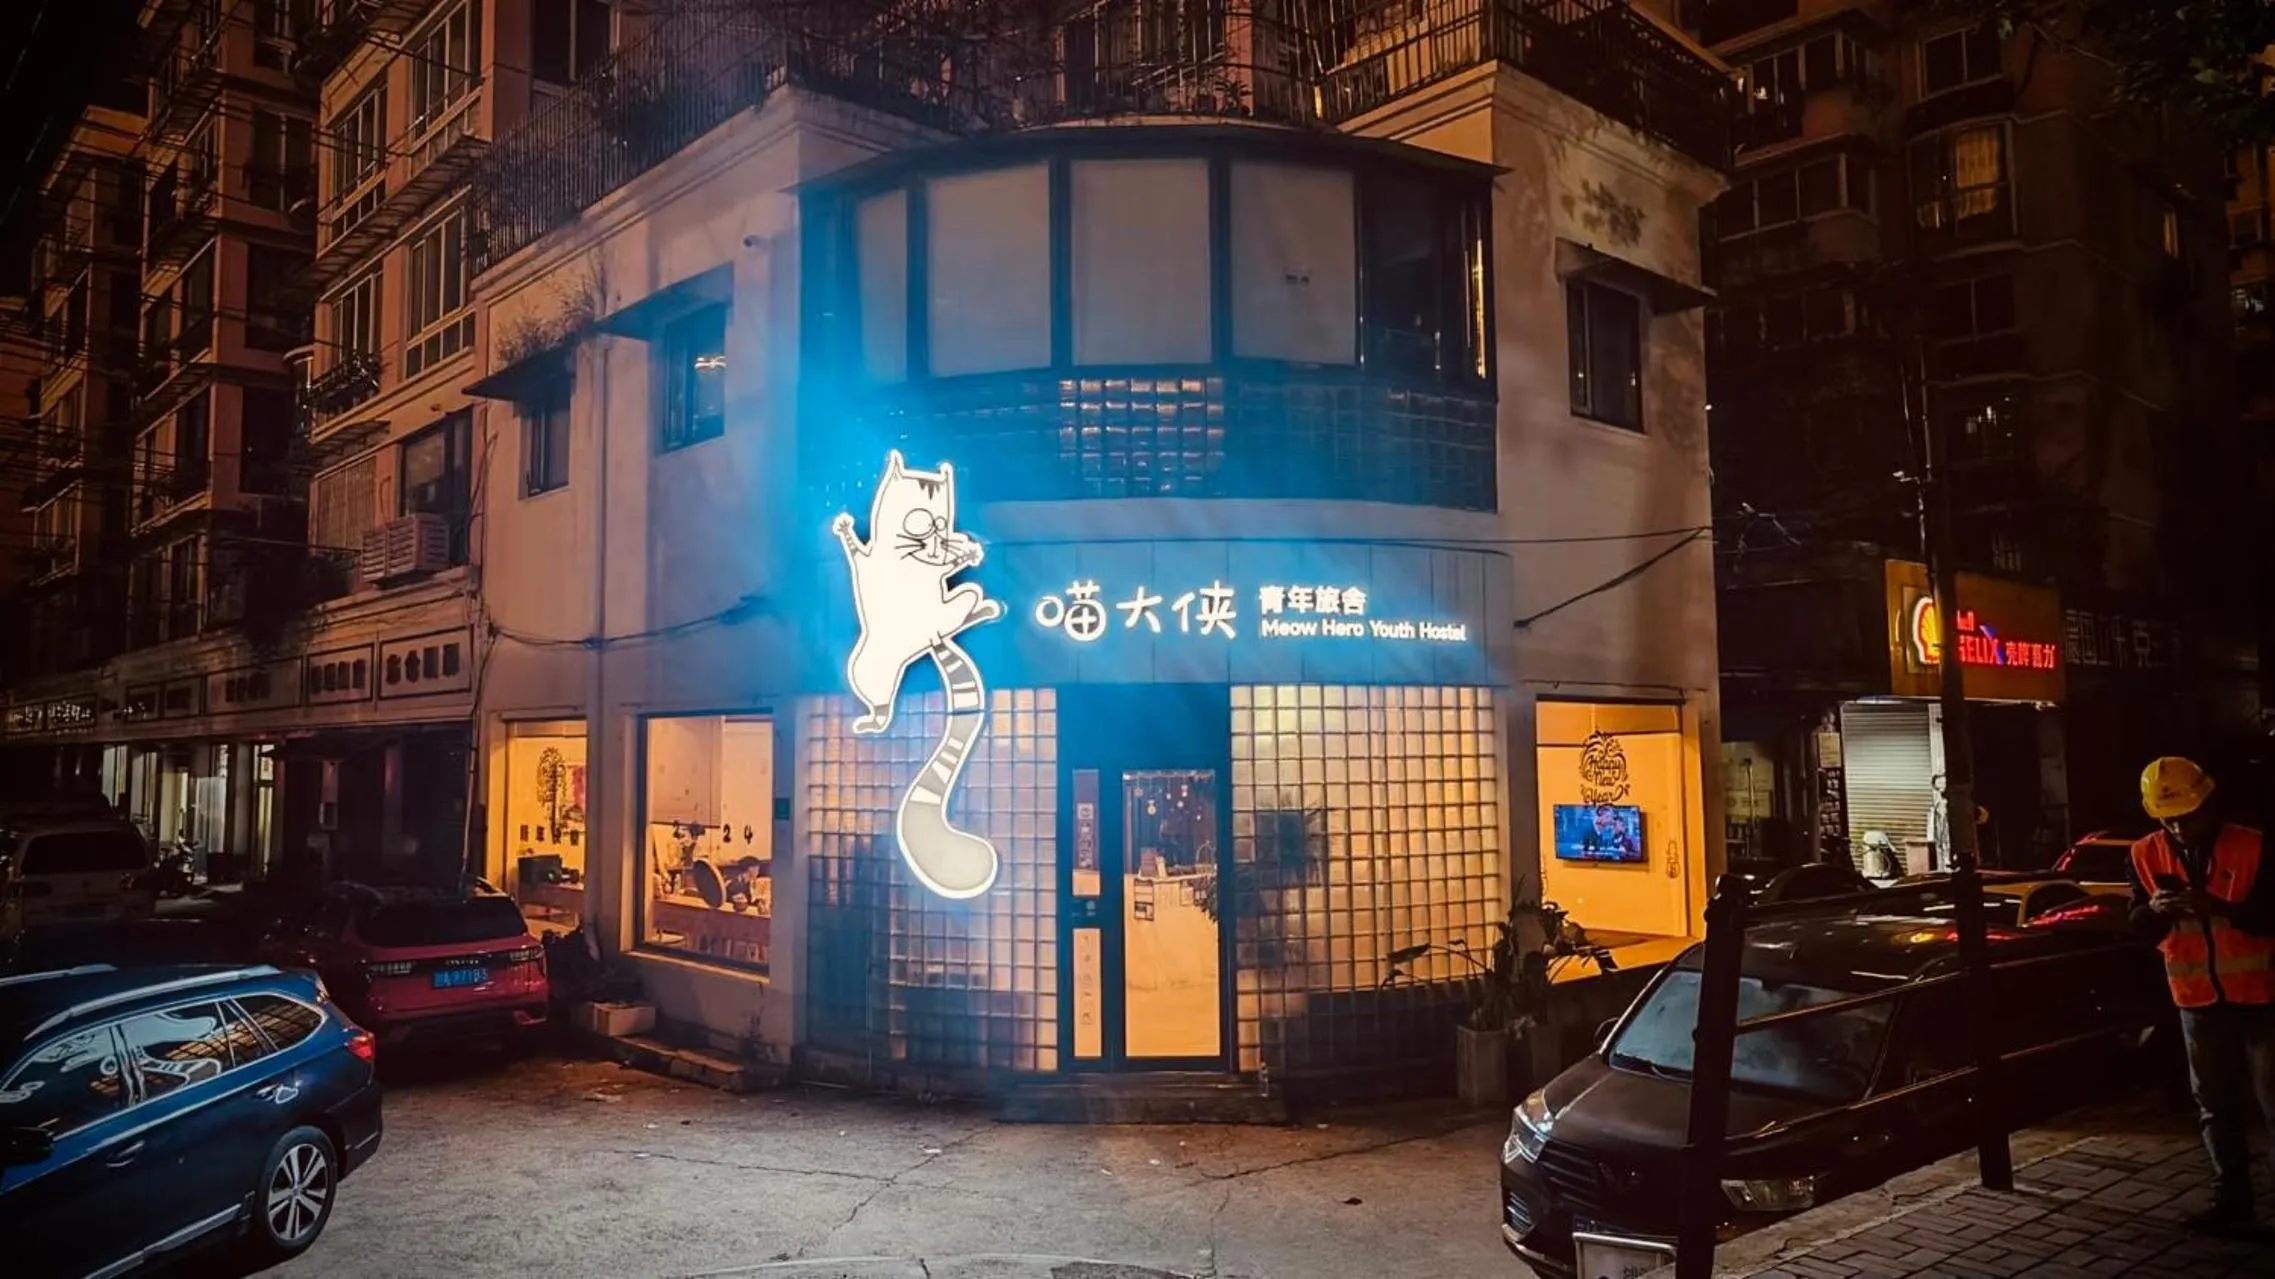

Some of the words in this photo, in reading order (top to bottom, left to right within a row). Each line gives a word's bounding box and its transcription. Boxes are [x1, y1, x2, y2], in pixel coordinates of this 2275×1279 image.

[1035, 579, 1238, 642] 喵大侠
[1258, 585, 1368, 615] 青年旅舍
[1261, 619, 1318, 637] Meow
[1322, 619, 1365, 637] Hero
[1369, 620, 1415, 639] Youth
[1419, 622, 1467, 641] Hostel
